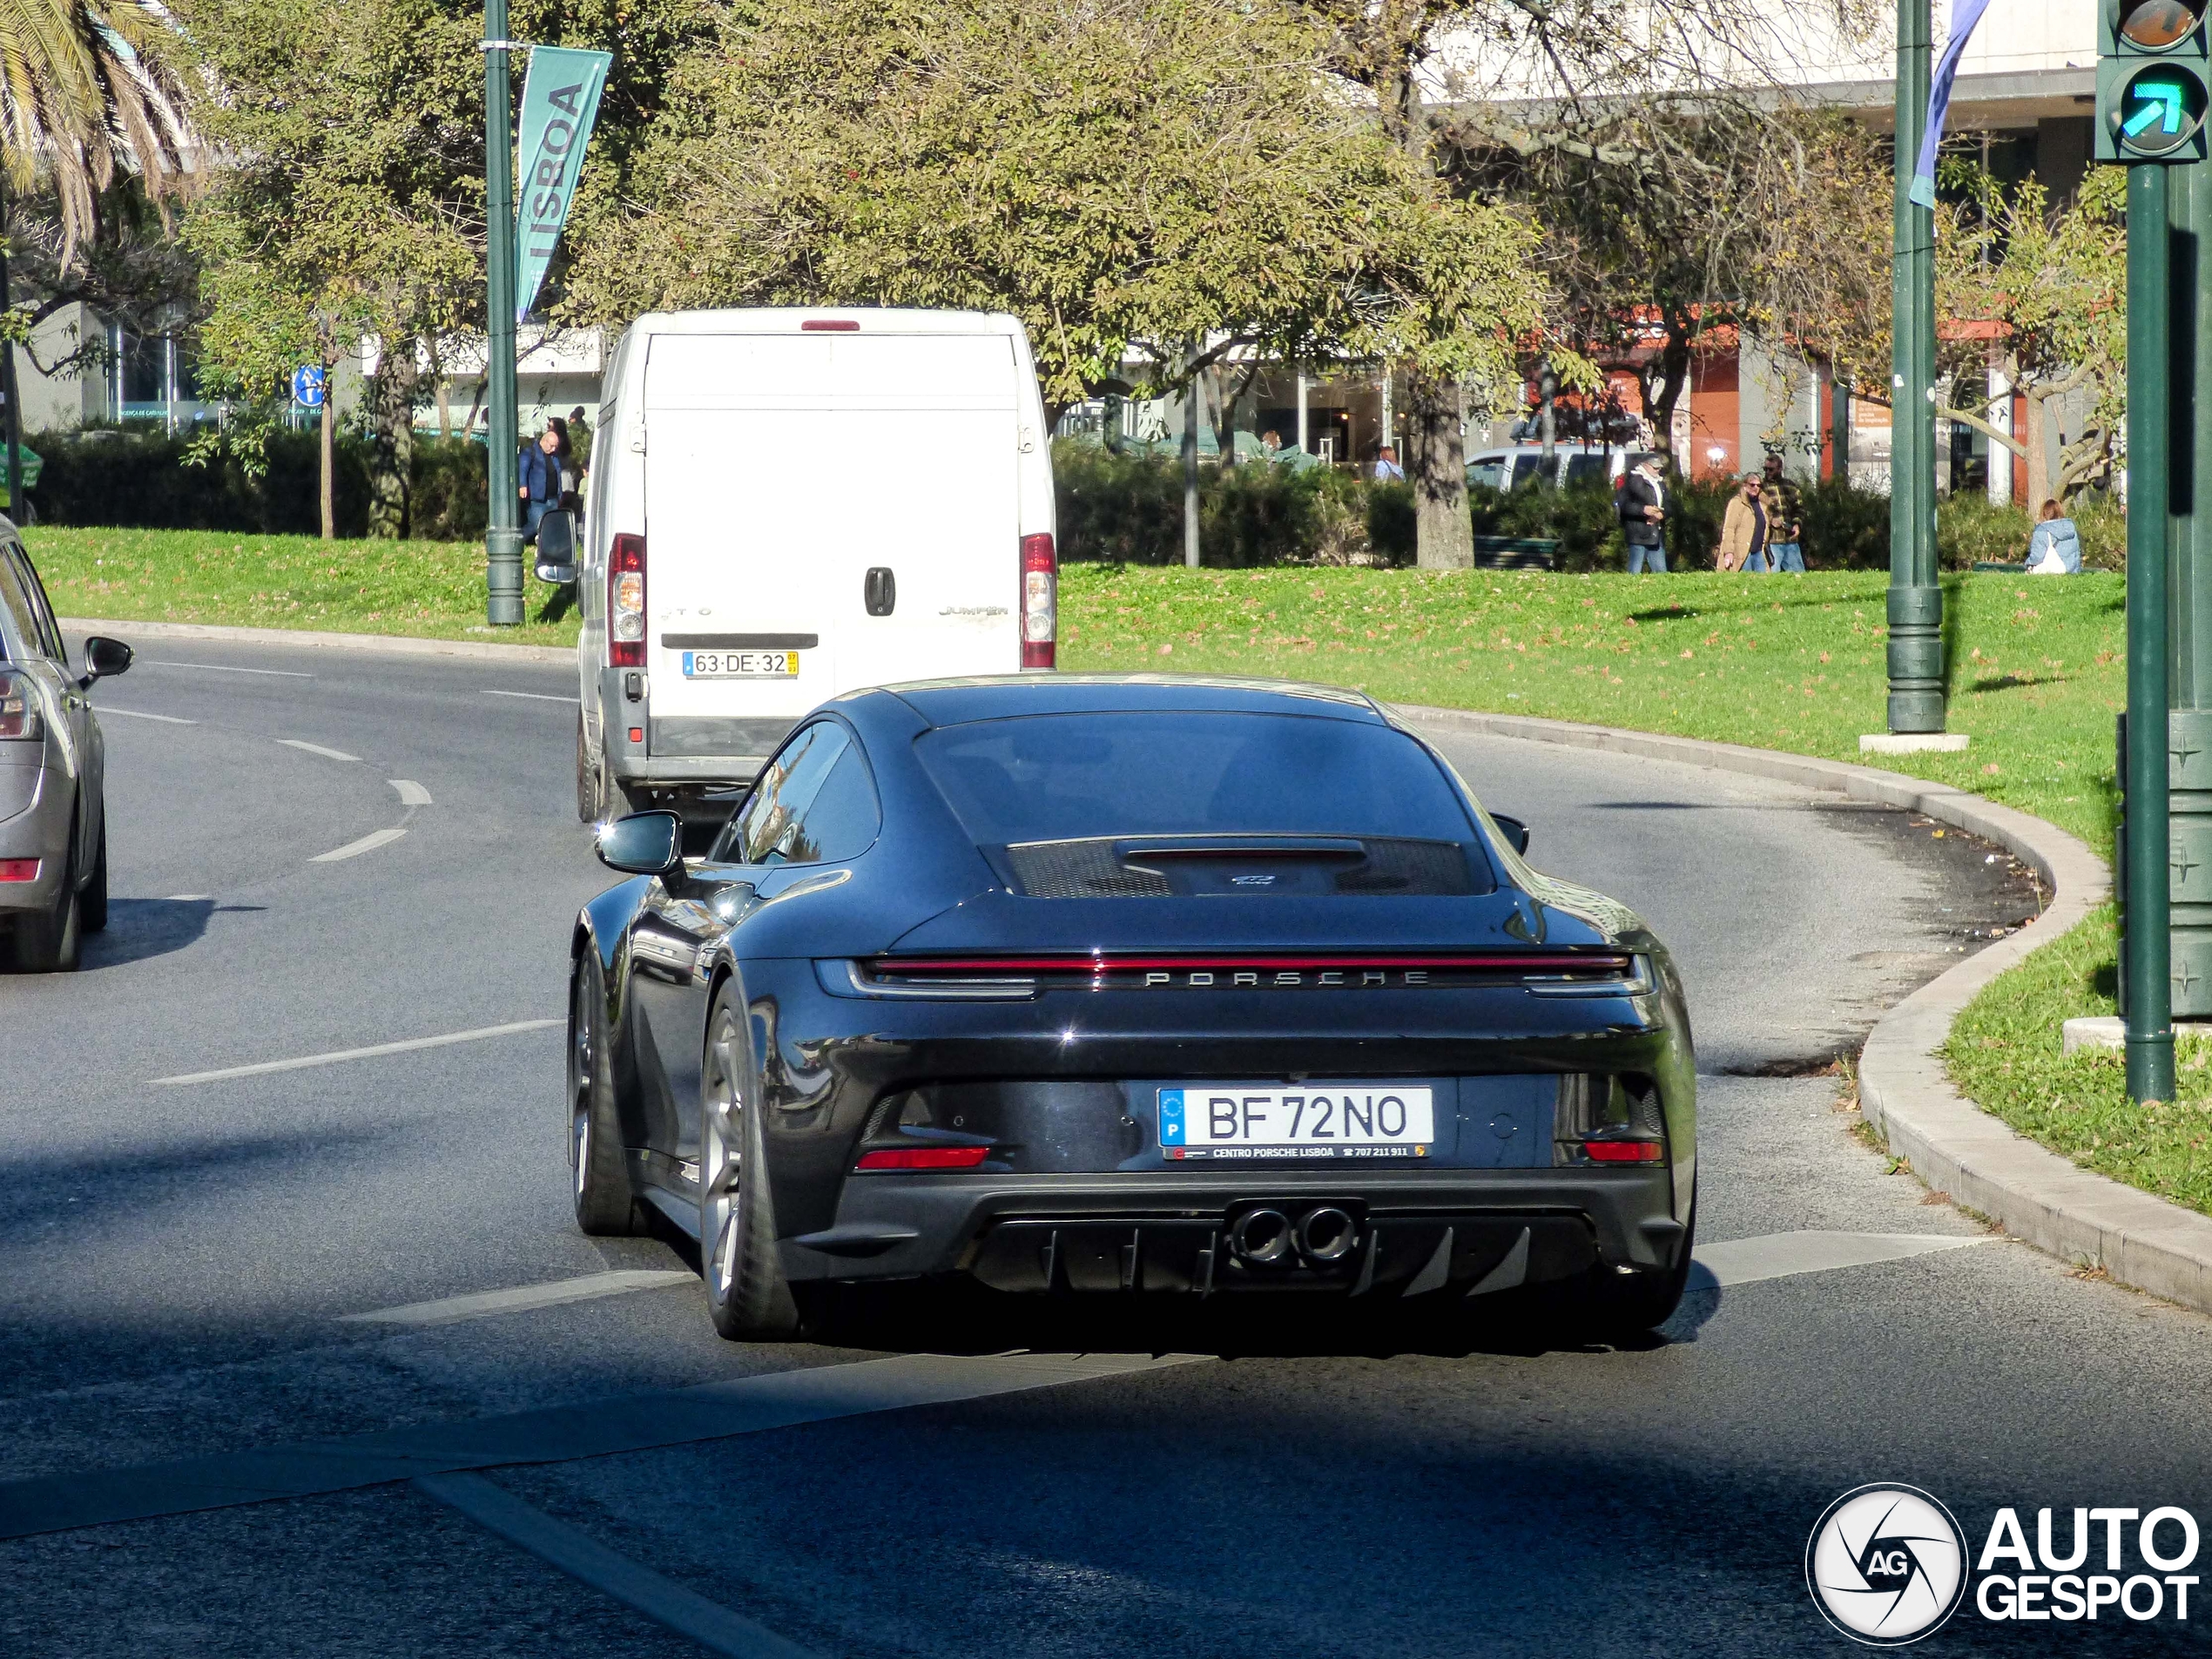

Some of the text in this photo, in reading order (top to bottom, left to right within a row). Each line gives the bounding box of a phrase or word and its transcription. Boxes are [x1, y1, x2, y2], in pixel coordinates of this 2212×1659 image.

[1144, 972, 1429, 987] PORSCHE
[1168, 1124, 1179, 1136] P
[1212, 1149, 1252, 1158] CENTRO
[1253, 1148, 1298, 1158] PORSCHE
[1299, 1148, 1334, 1157] LISBOA
[1354, 1147, 1372, 1157] 707
[1372, 1147, 1390, 1157] 211
[1391, 1147, 1408, 1157] 911
